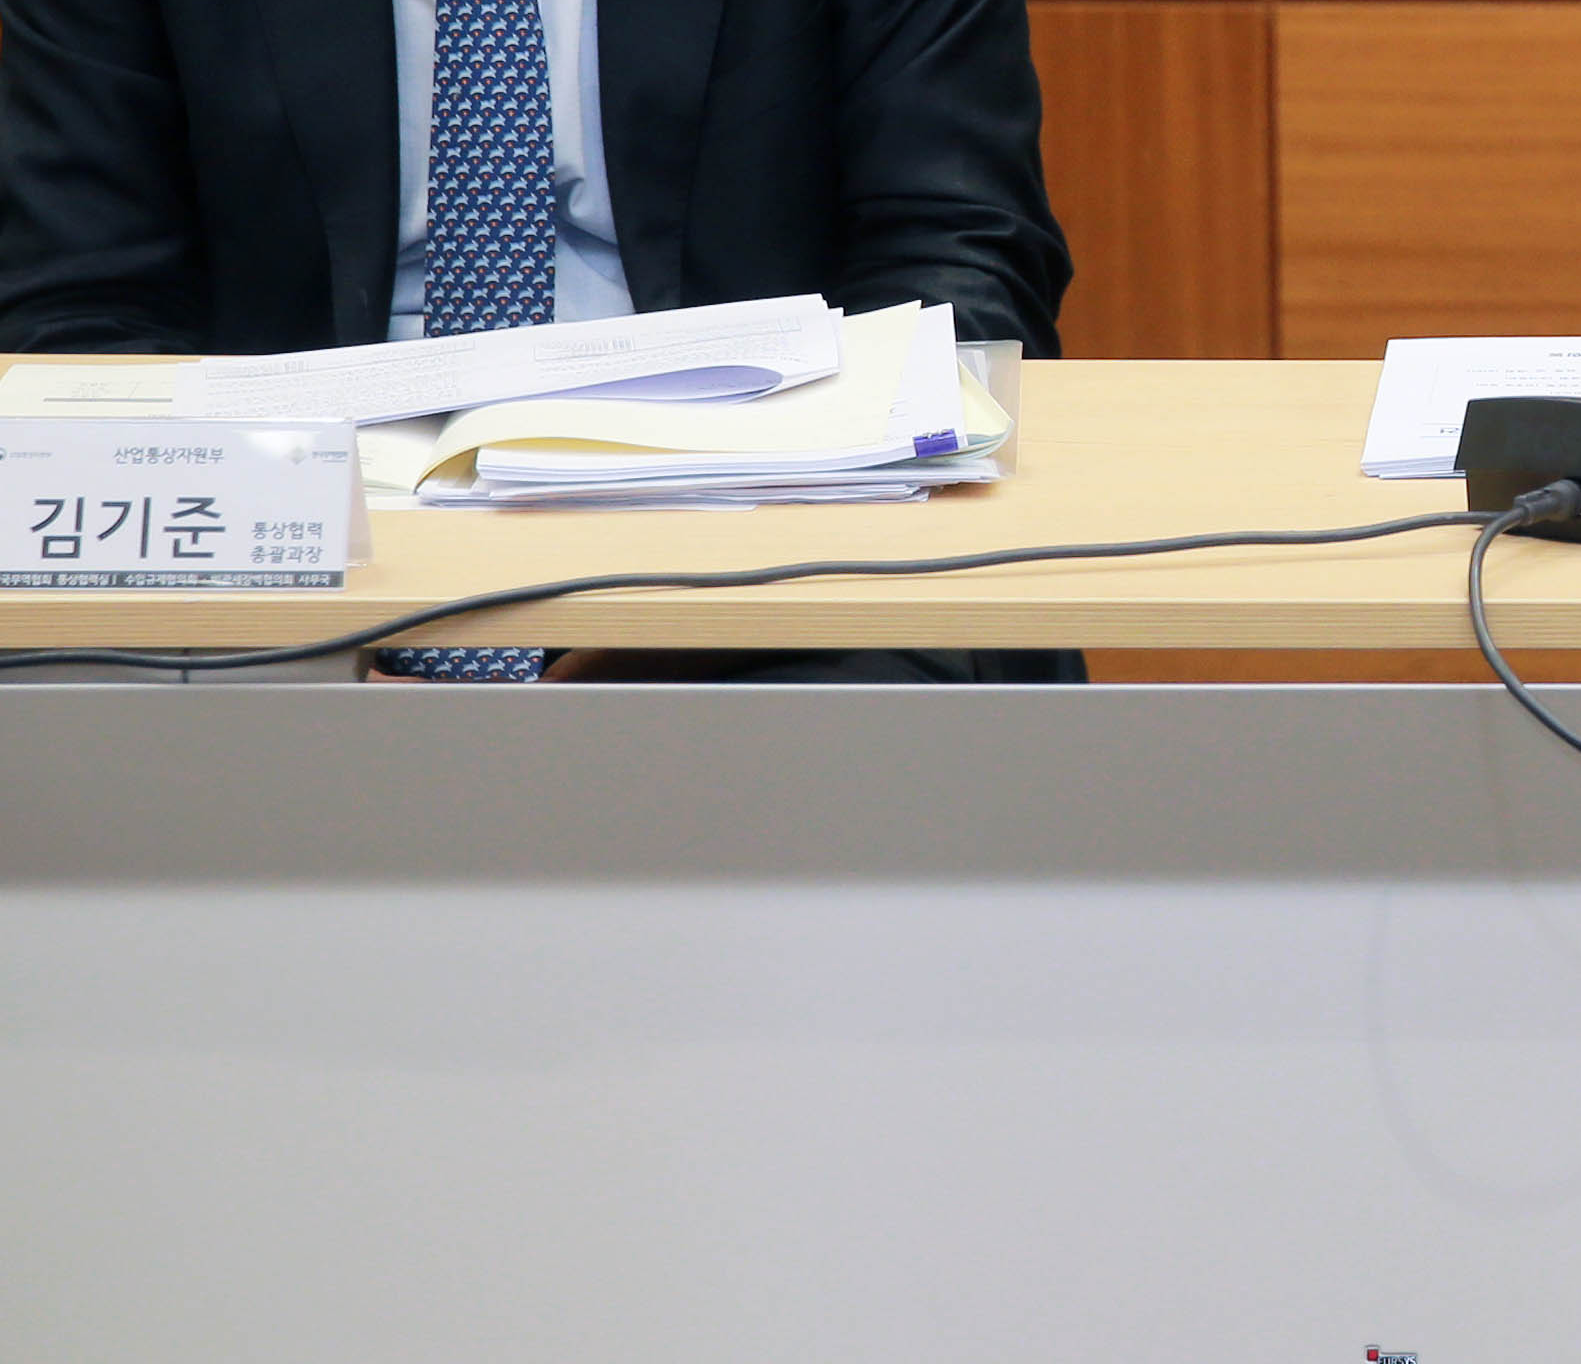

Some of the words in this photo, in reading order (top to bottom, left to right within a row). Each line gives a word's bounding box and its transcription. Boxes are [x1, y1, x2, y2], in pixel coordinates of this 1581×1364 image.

[114, 446, 225, 465] 산업통상자원부
[30, 496, 226, 560] 김기준
[252, 520, 323, 541] 통상협력
[250, 544, 323, 564] 총괄과장
[0, 573, 53, 586] 국무역협회
